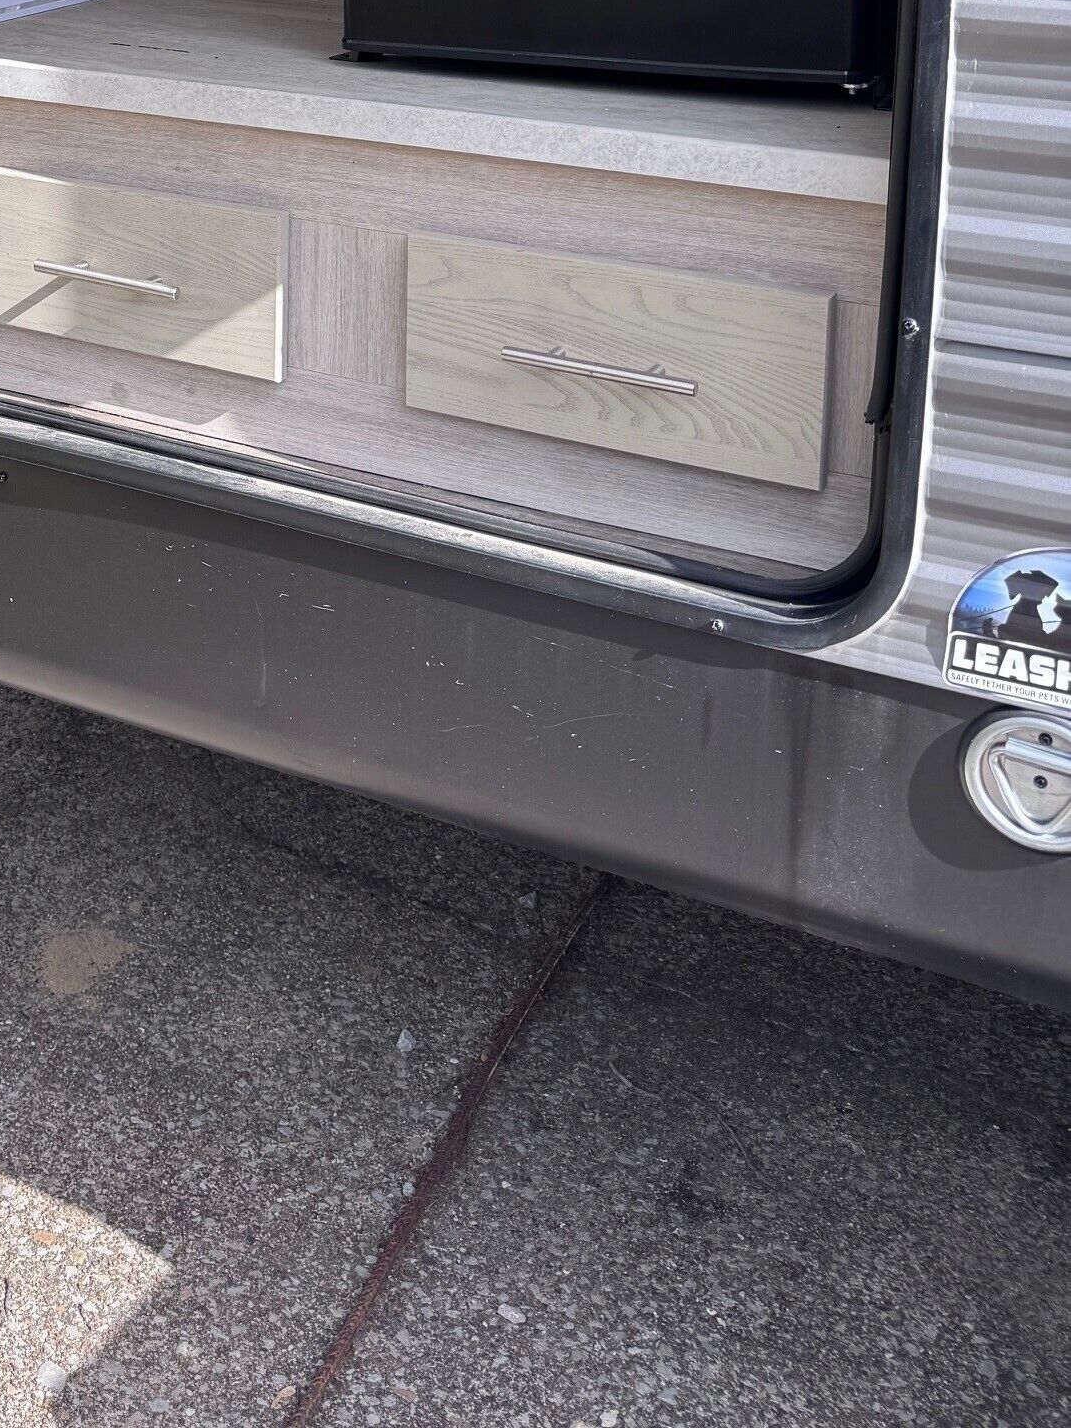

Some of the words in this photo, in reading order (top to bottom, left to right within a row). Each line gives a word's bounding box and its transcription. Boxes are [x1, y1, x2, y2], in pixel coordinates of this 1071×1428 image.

[951, 673, 979, 684] SAFELY
[982, 679, 1012, 692] TETHER
[1015, 685, 1036, 698] YOUR
[1038, 692, 1059, 704] PETS
